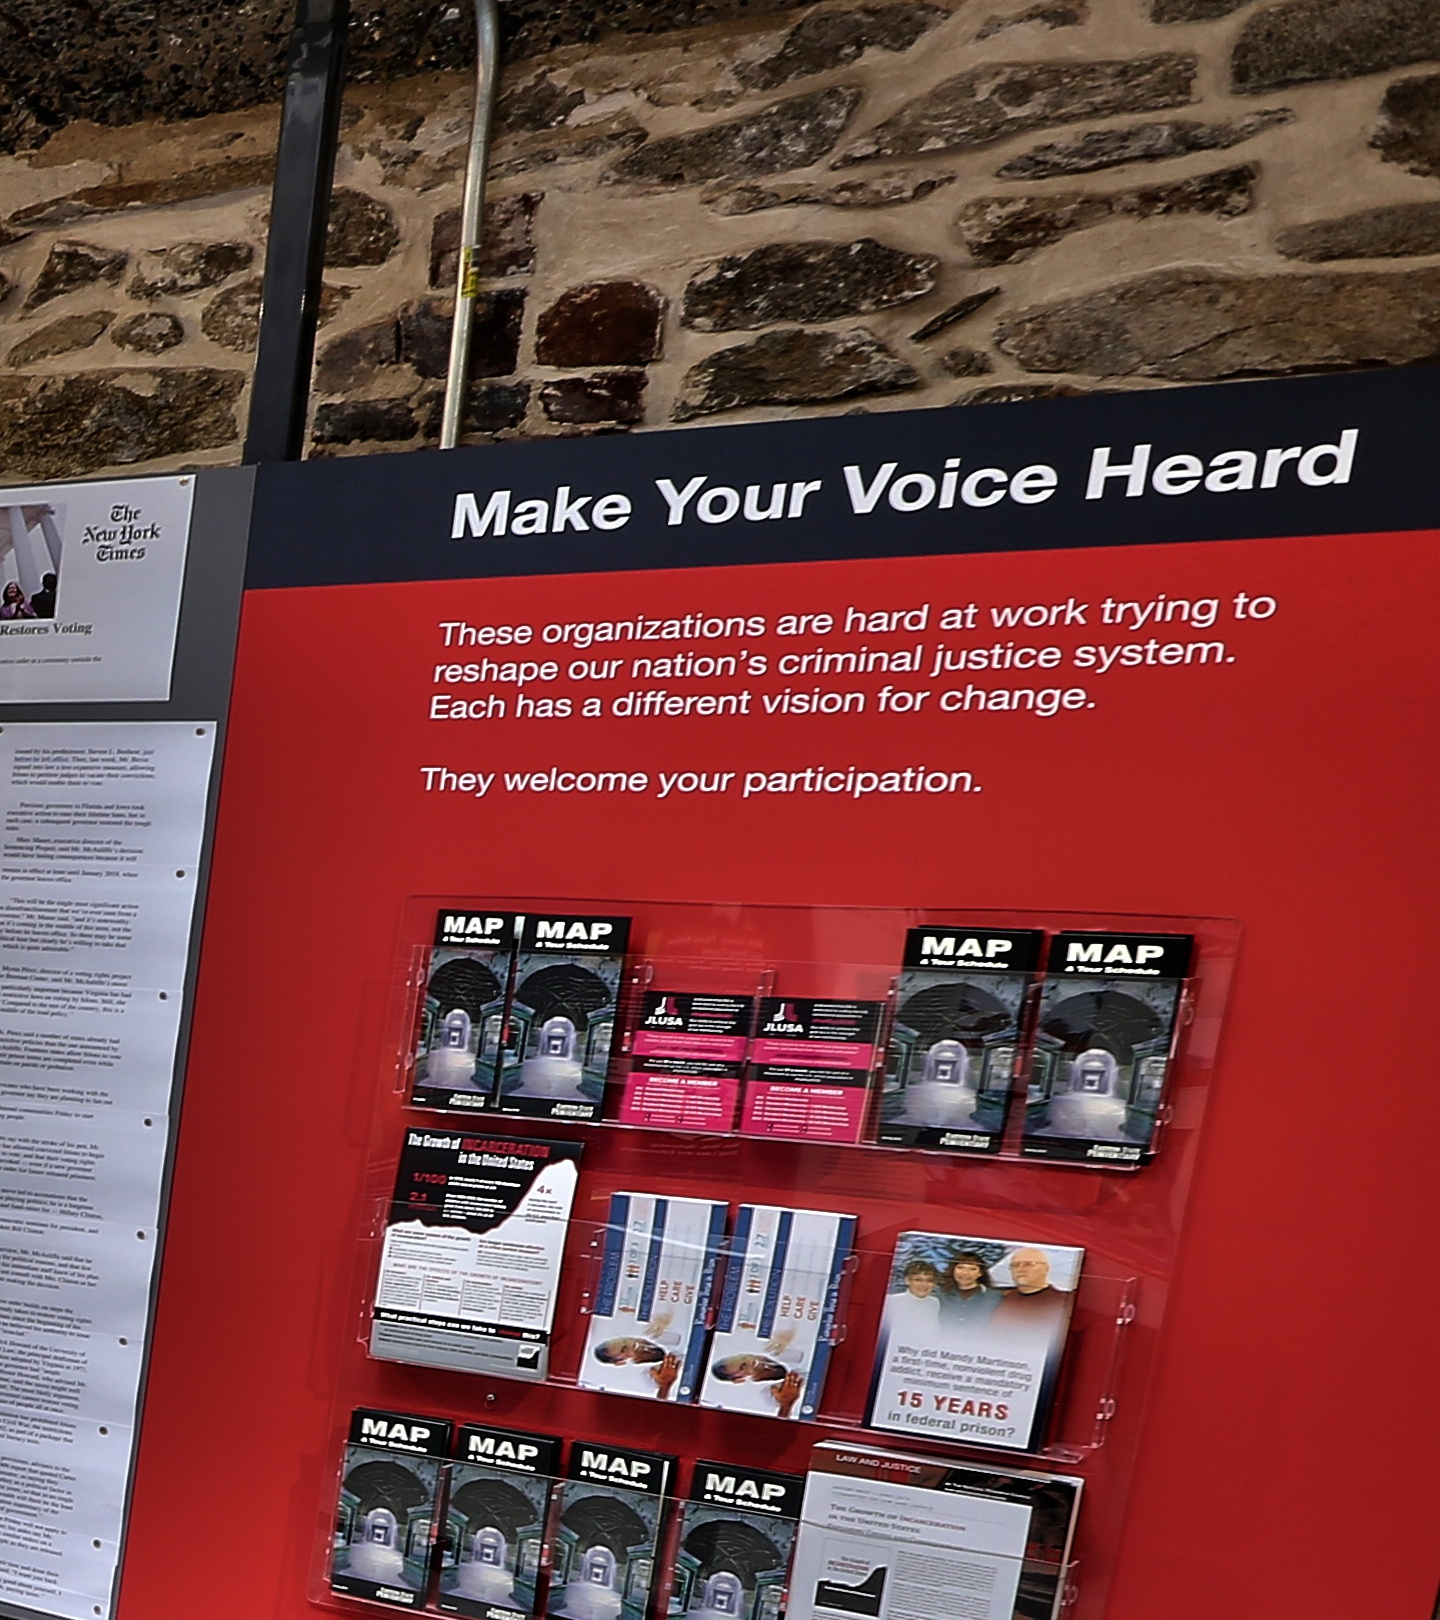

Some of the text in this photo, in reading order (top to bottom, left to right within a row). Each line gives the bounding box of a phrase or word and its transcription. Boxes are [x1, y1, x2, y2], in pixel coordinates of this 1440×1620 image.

[451, 428, 1359, 539] Make Your Voice Heard
[110, 504, 141, 523] The
[82, 522, 161, 545] New York
[96, 546, 147, 562] Times
[0, 623, 49, 636] Restores
[52, 621, 93, 635] Voting
[439, 592, 1276, 648] These organizations are hard at work trying to
[434, 639, 1235, 687] reshape our nation's criminal justice system.
[444, 916, 504, 935] MAP
[536, 921, 613, 940] MAP
[921, 936, 1012, 958] MAP
[1066, 942, 1164, 964] MAP
[644, 1016, 683, 1027] JLUSA
[763, 1023, 804, 1034] JLUSA
[898, 1391, 1009, 1421] 15 YEARS
[361, 1418, 431, 1443] MAP
[887, 1410, 1015, 1438] in federal prison?
[468, 1435, 538, 1461] MAP
[581, 1450, 651, 1478] MAP
[836, 1454, 922, 1474] LAW AND JUSTICE
[705, 1473, 786, 1501] MAP
